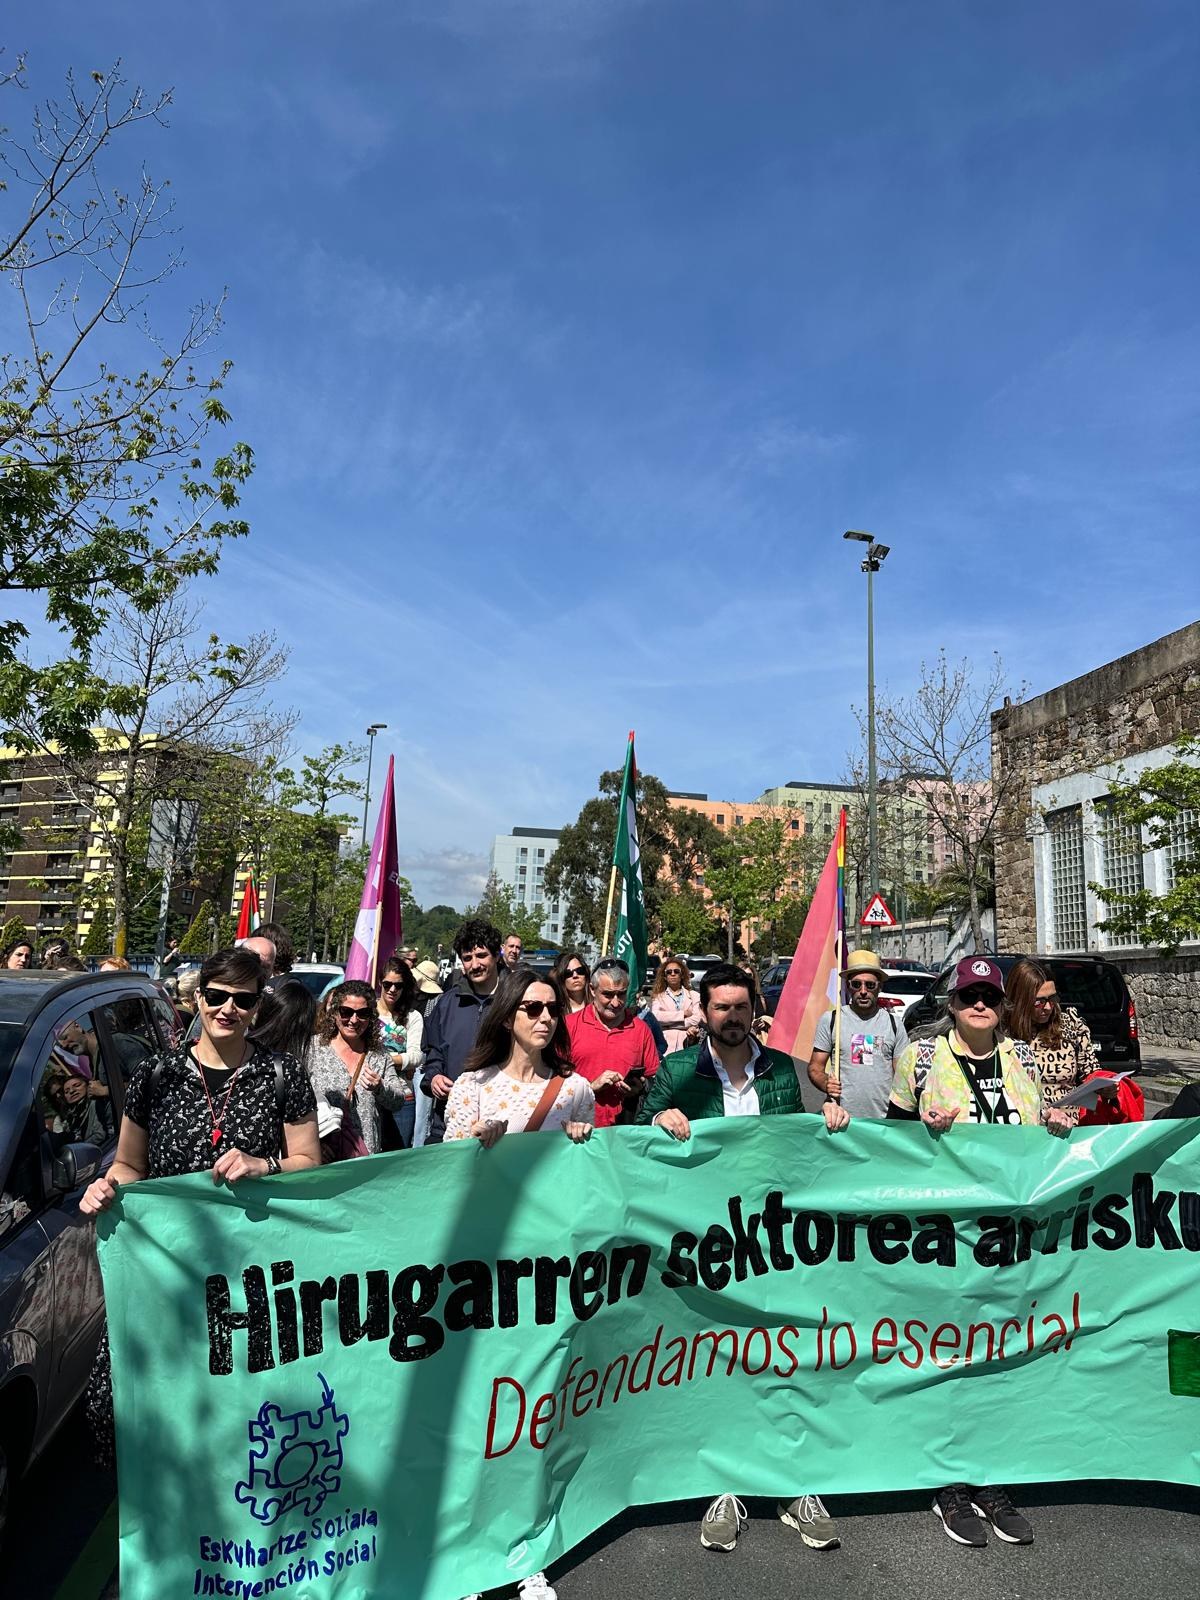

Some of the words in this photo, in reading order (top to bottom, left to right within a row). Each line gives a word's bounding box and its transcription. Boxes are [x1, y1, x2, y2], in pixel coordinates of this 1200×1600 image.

[206, 1244, 652, 1376] Hirugarren
[661, 1190, 957, 1291] sektorea
[484, 1324, 798, 1459] Defendamos
[814, 1306, 857, 1371] lo
[871, 1292, 1081, 1370] esencial
[311, 1508, 377, 1539] Soziala
[323, 1535, 377, 1576] Social
